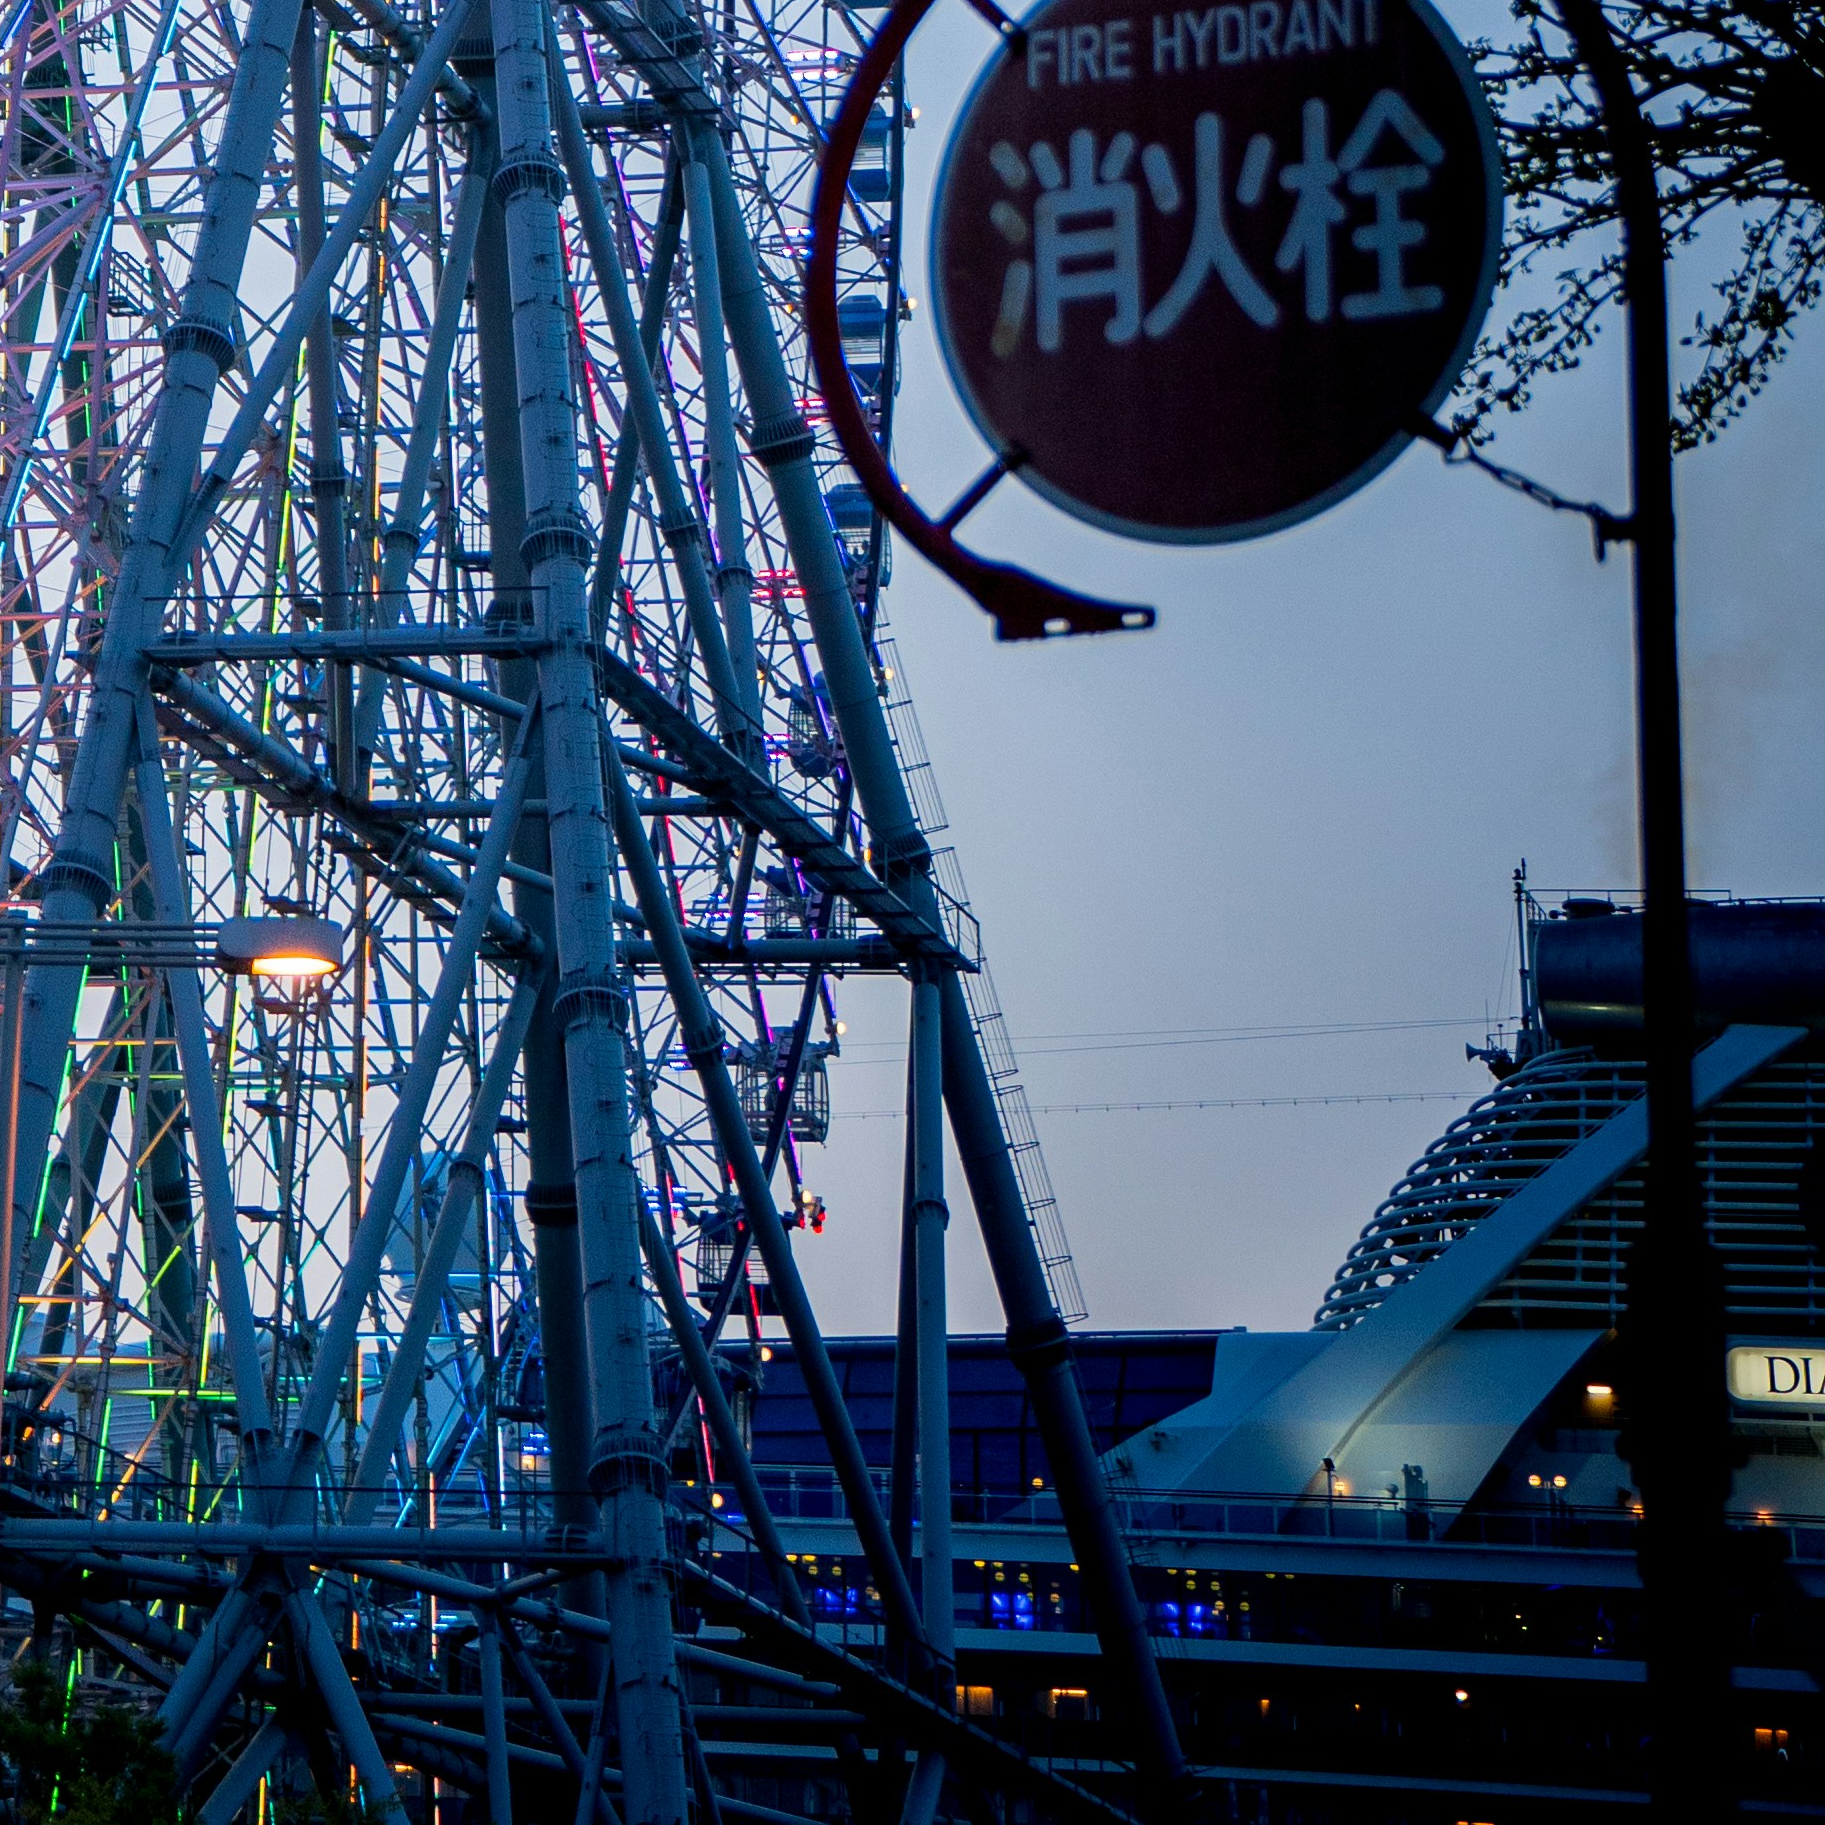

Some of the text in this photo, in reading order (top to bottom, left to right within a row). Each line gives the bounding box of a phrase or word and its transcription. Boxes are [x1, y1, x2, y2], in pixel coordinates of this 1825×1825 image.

[1027, 20, 1132, 88] FIRE
[989, 90, 1445, 357] 消火栓
[1764, 1356, 1825, 1394] DI
